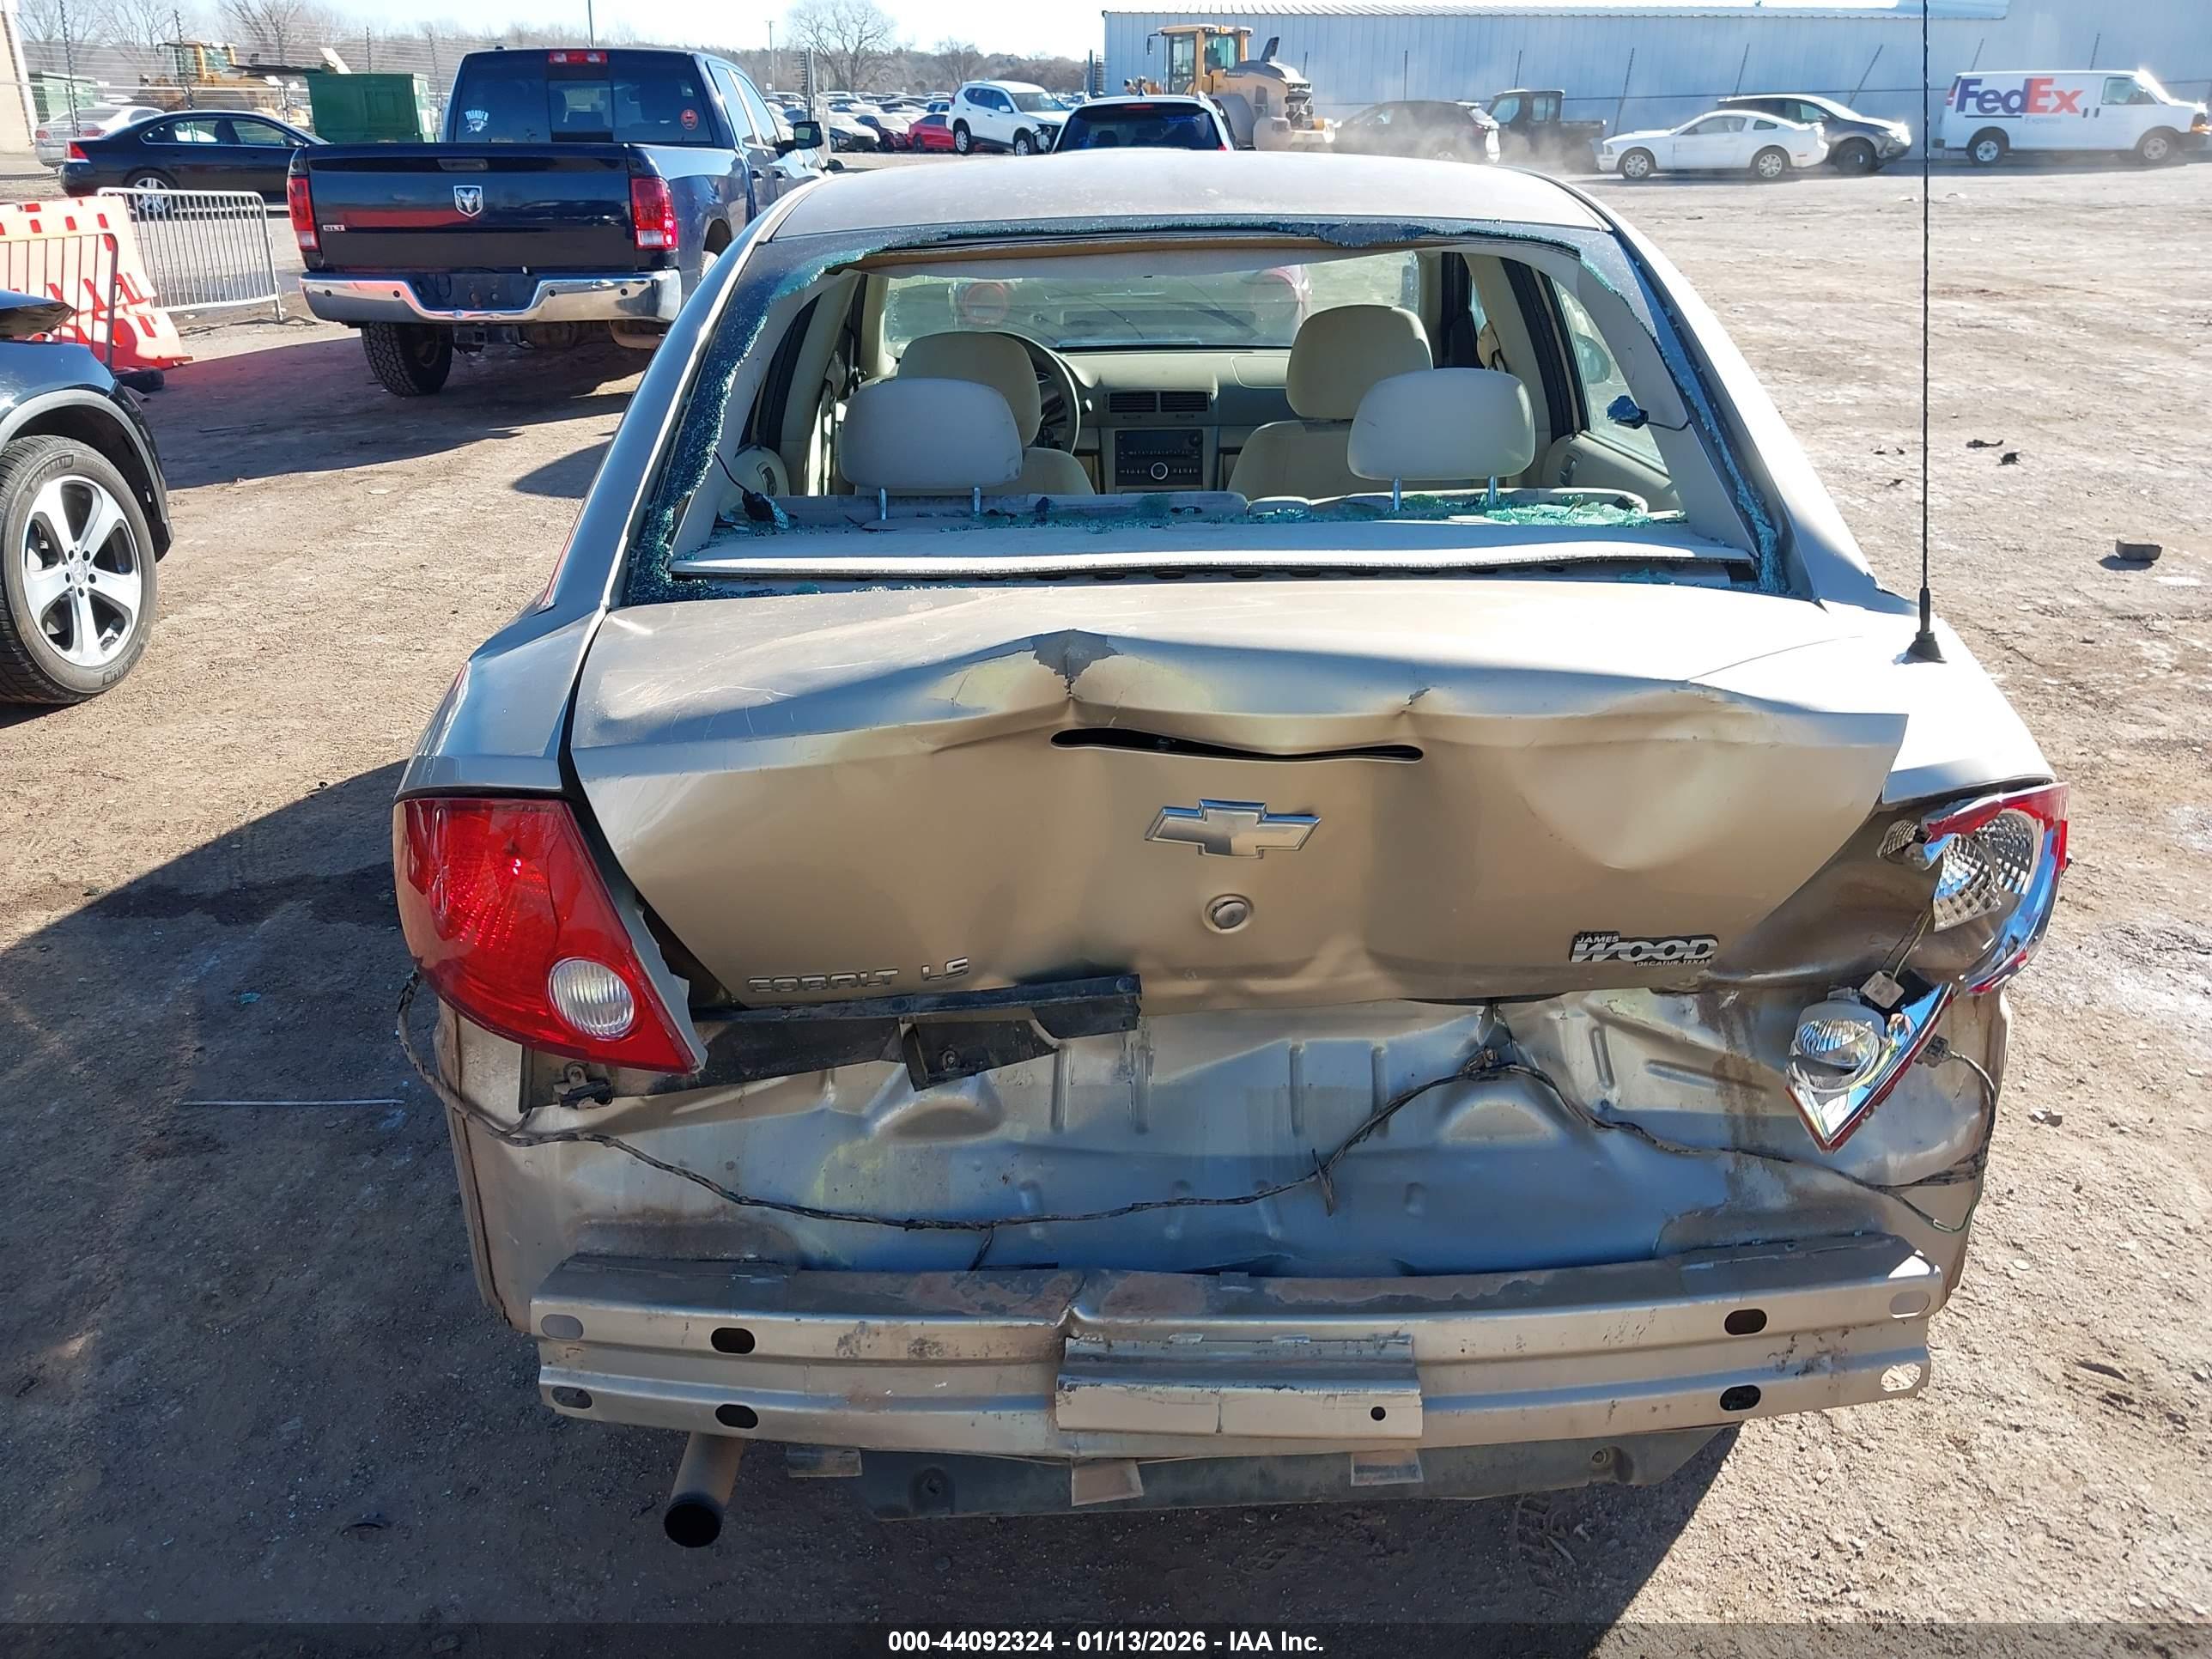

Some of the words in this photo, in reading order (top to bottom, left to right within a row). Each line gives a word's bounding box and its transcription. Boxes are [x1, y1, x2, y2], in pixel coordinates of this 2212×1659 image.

[1955, 77, 2085, 115] FedEx
[1571, 939, 1718, 963] WOOD
[1577, 935, 1620, 944] JAMES
[747, 968, 900, 993] COBALT
[921, 956, 969, 982] LS
